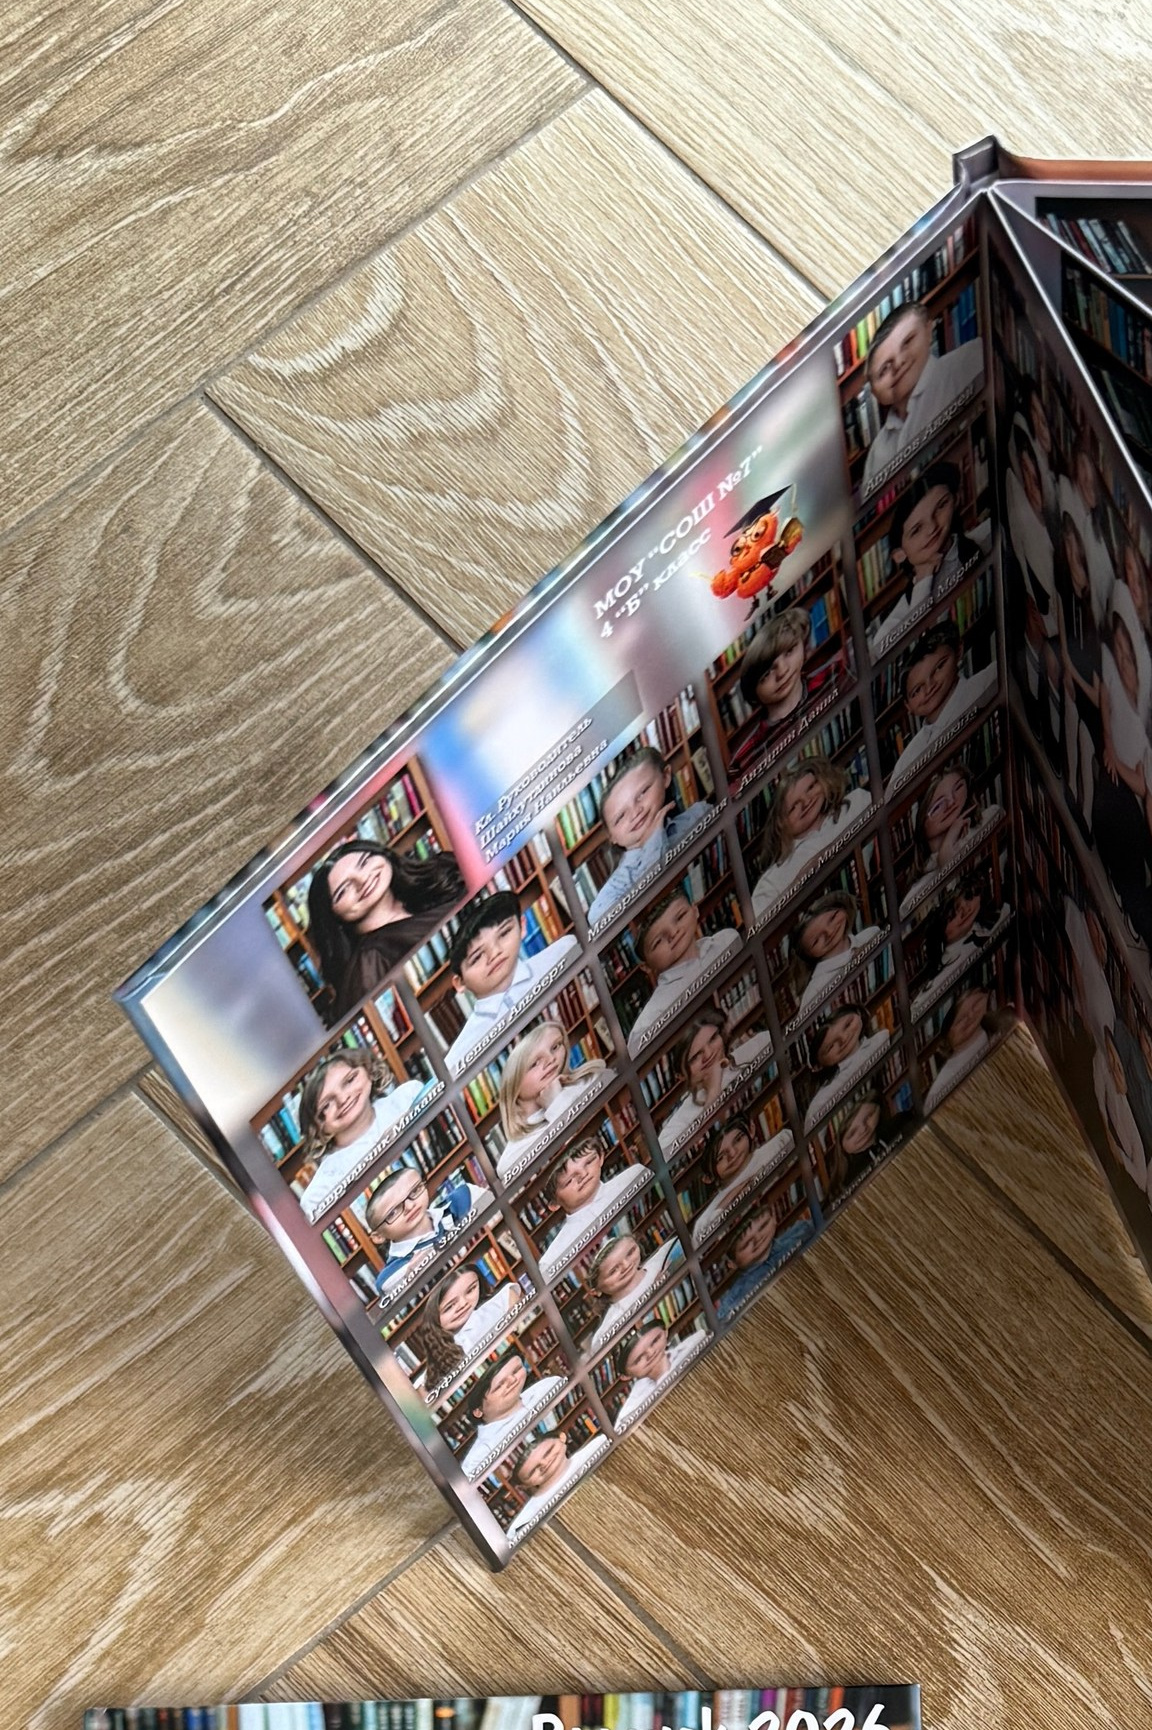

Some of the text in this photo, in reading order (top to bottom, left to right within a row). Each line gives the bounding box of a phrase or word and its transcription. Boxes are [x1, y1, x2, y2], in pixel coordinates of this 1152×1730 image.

[593, 558, 646, 621] МОУ
[598, 617, 613, 643] 4
[652, 522, 712, 592] класс
[879, 546, 979, 655] Исакова Мария
[473, 712, 594, 838] Кл. Руководитель
[483, 735, 609, 867] Мария Наильевна
[585, 793, 728, 944] Макарьева Виктория
[745, 793, 884, 941] Дмитриева Мирослава
[506, 955, 568, 1023] Альберт
[684, 946, 732, 1001] Михаил
[732, 1043, 771, 1091] Дарья
[307, 1078, 446, 1221] Гаврильчик Милана
[501, 1078, 602, 1186] Борисова Агата
[377, 1205, 478, 1310] Симаков Захар
